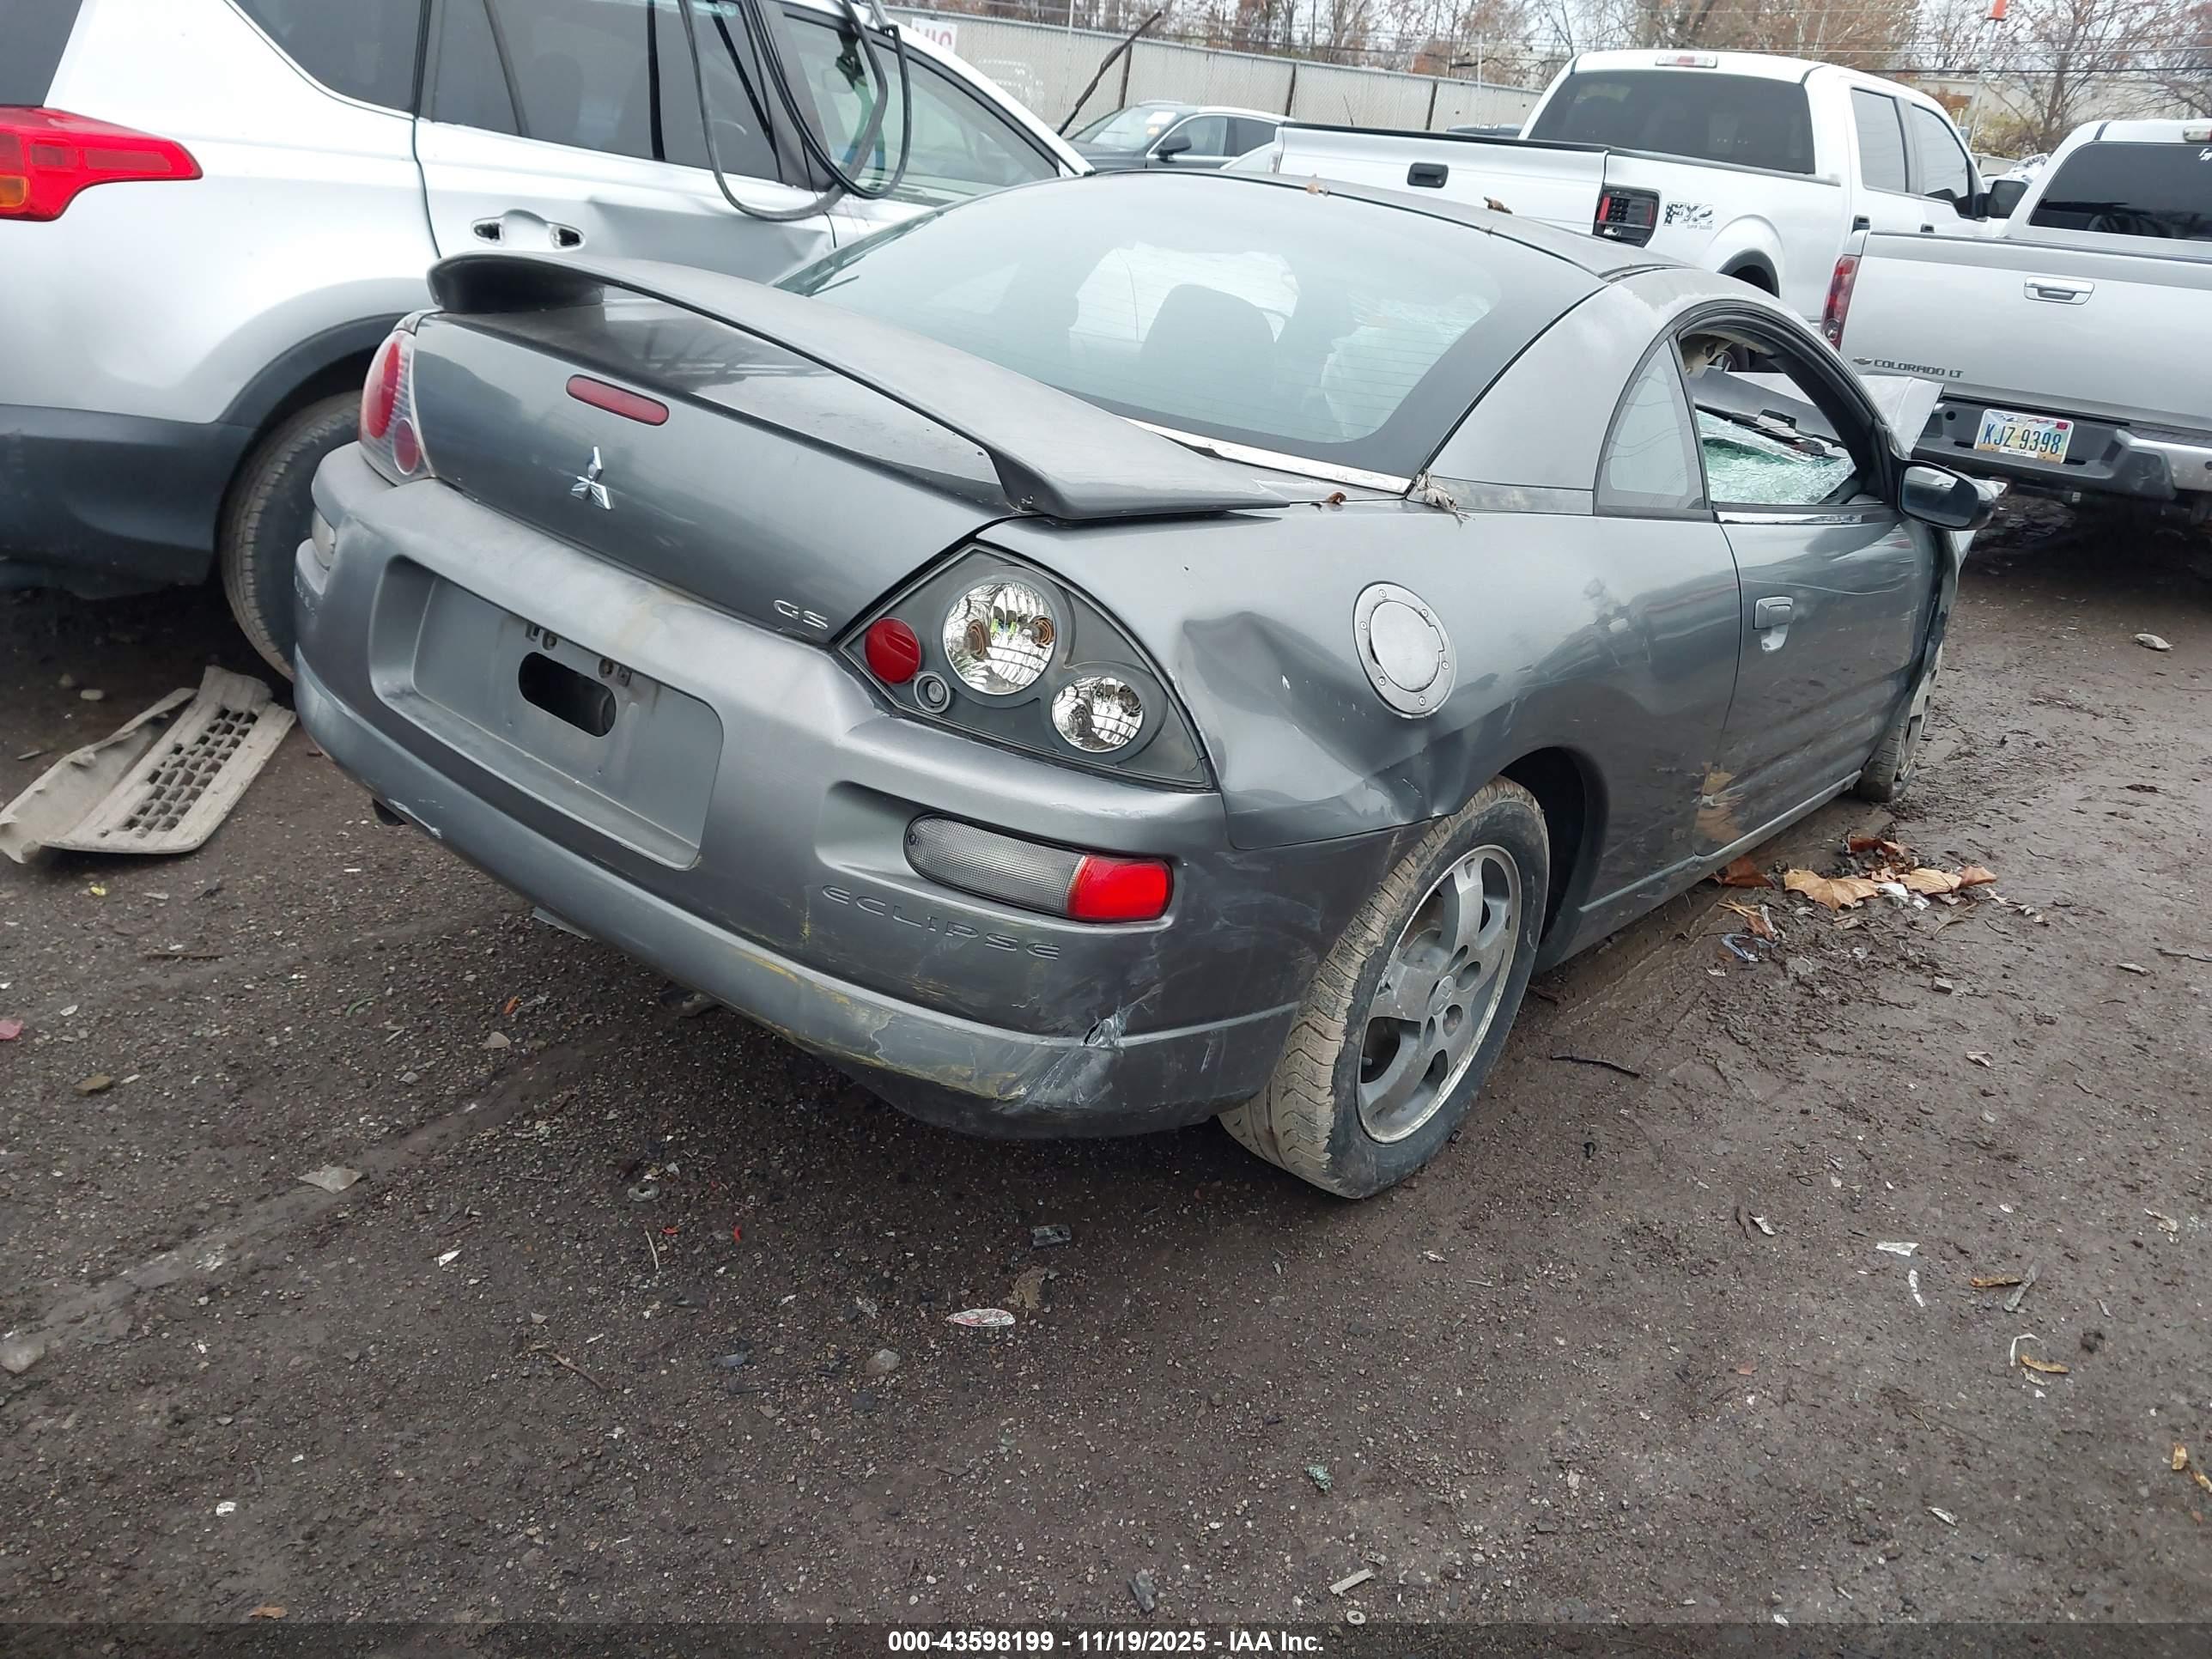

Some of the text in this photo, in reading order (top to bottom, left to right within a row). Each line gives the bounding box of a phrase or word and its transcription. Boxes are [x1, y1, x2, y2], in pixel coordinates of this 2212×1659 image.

[1663, 202, 1713, 226] FX4
[1874, 359, 1964, 379] COLORADO LT
[1983, 423, 2063, 454] KJZ 9398
[773, 599, 829, 630] GS
[822, 884, 1060, 960] ECLIPSE
